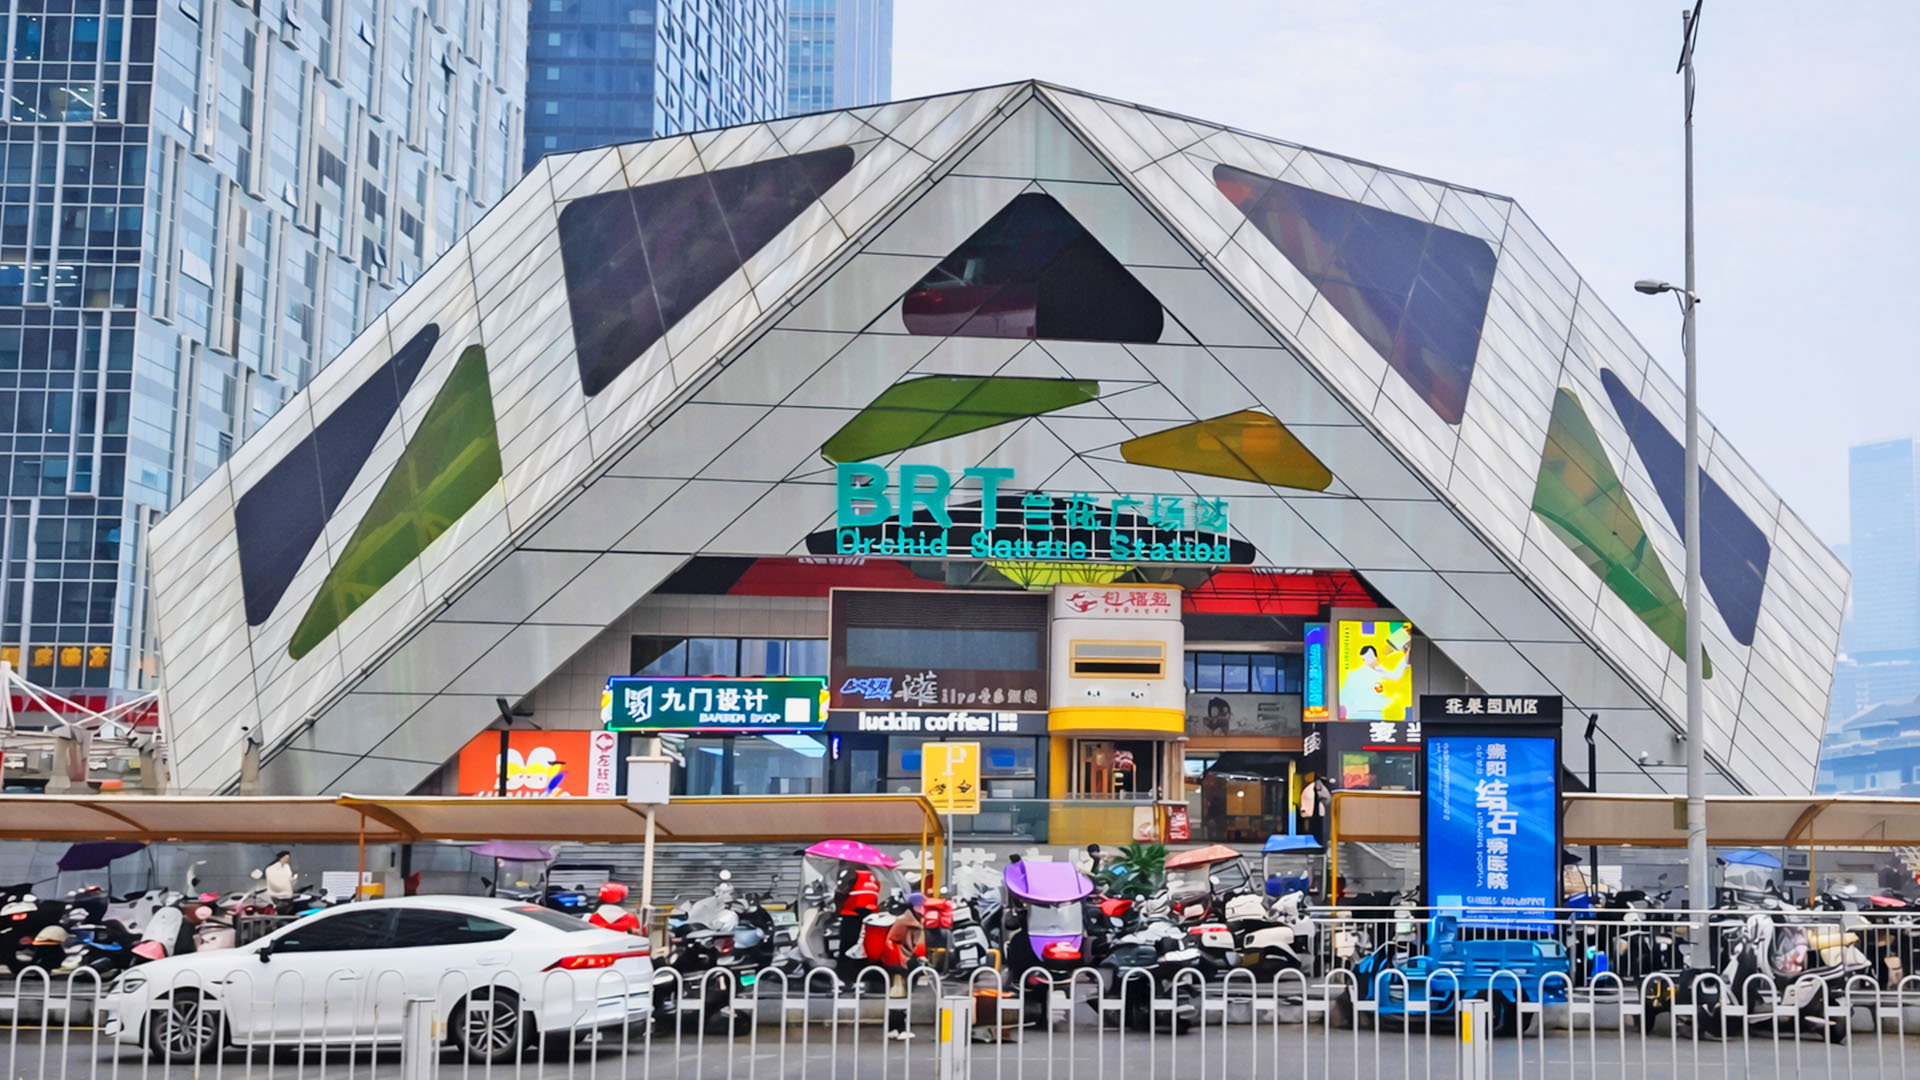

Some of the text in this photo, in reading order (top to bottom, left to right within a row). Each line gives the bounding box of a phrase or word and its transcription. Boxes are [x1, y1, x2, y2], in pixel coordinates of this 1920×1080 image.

[836, 461, 1015, 530] BRT
[836, 527, 1230, 562] Orchid Square Station
[659, 687, 769, 712] 九门设计
[858, 712, 921, 731] luckin
[924, 712, 990, 732] coffee
